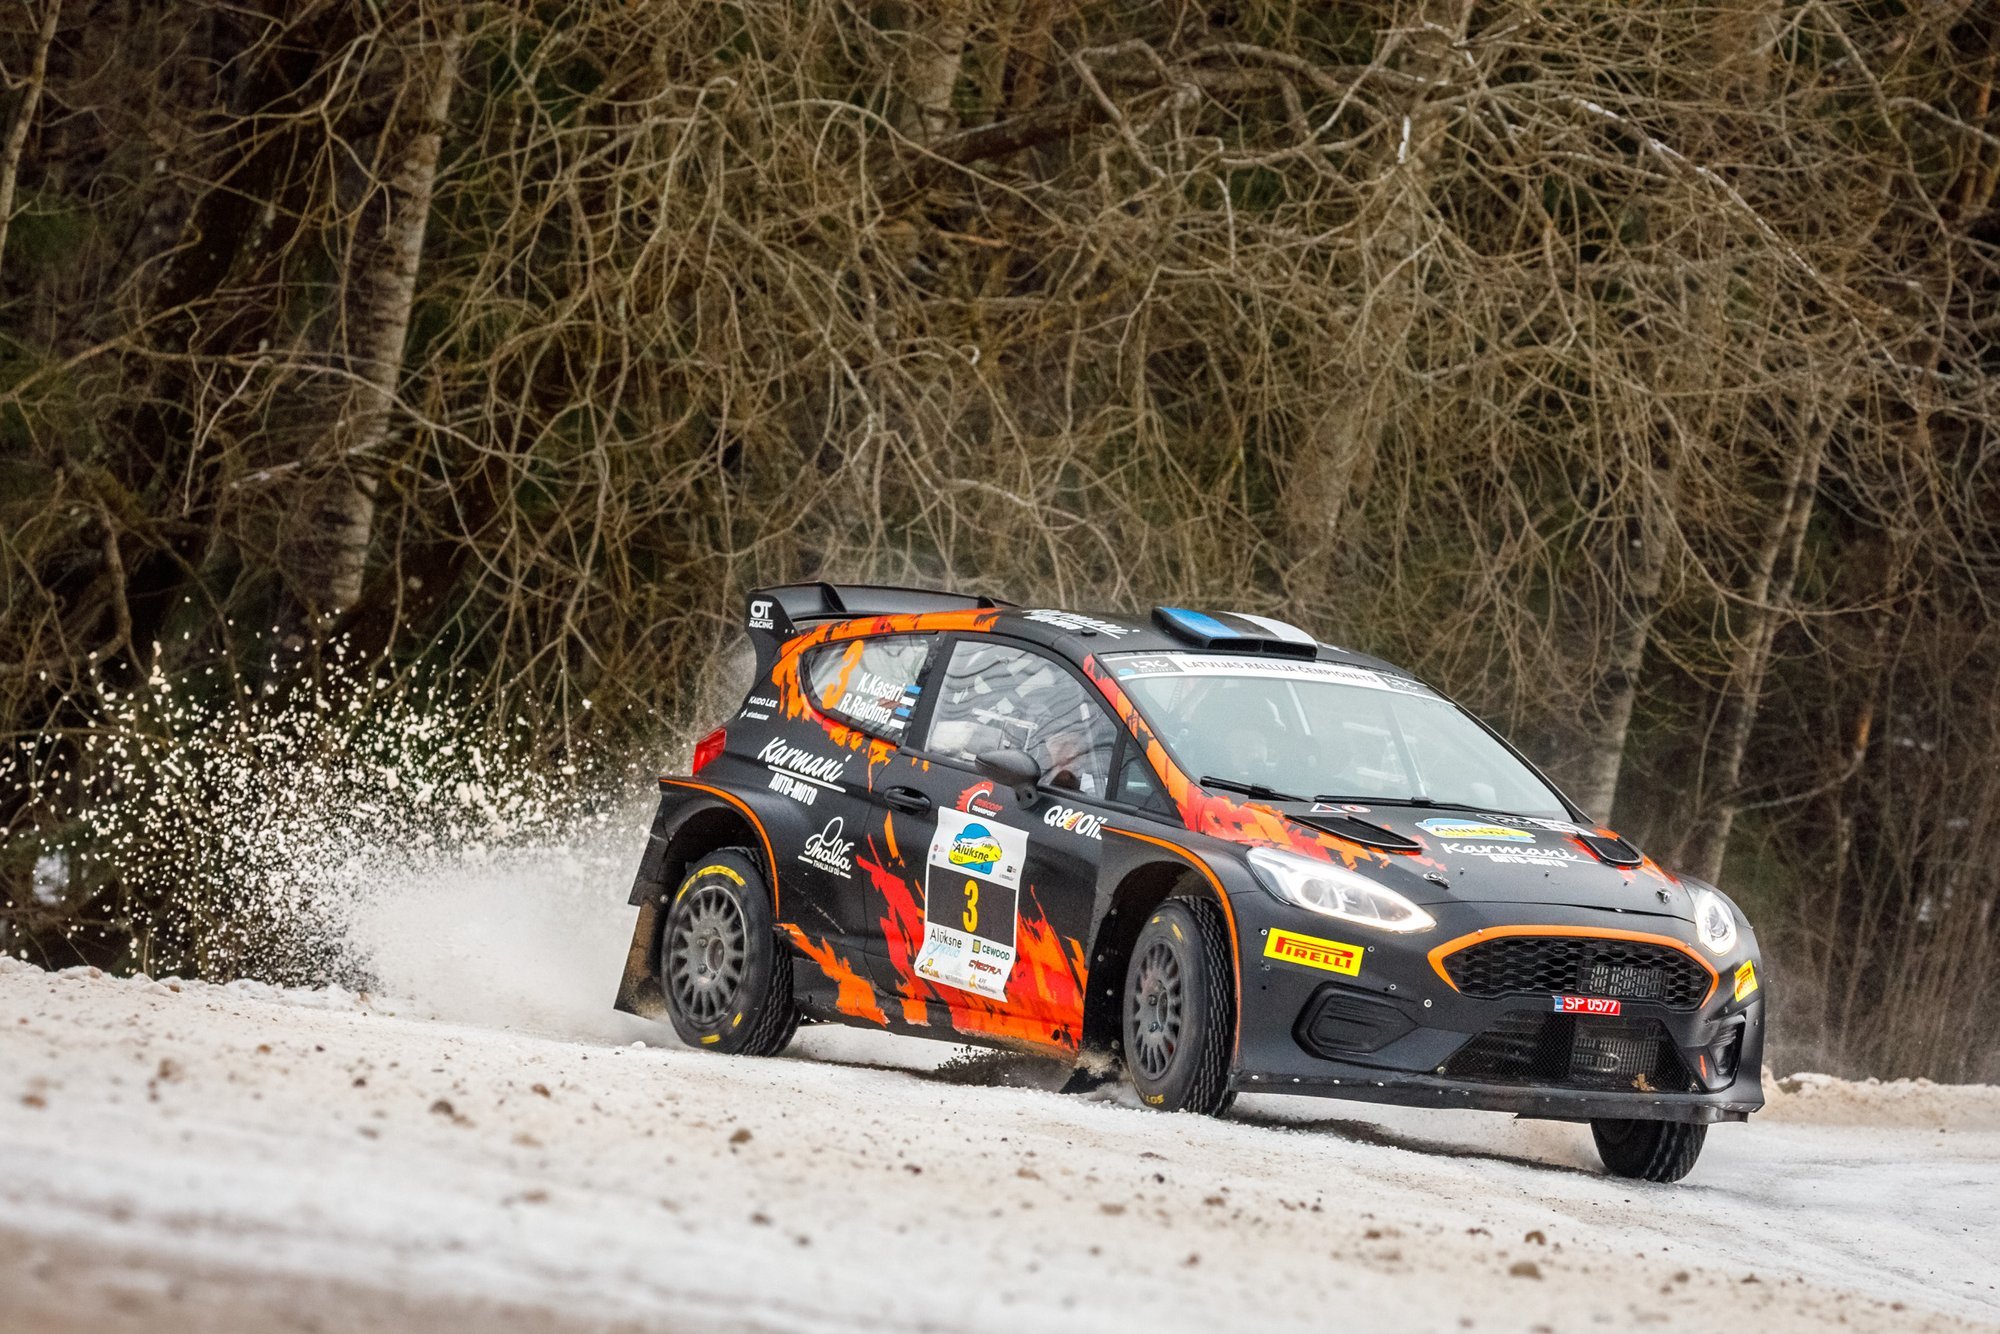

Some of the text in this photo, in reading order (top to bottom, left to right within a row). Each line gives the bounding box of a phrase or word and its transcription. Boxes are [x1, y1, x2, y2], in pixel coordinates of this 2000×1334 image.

[750, 600, 773, 619] OT
[749, 620, 774, 630] RACING
[822, 639, 865, 710] 3
[1183, 660, 1244, 670] LATVIJAS
[1245, 662, 1296, 672] RALLIJA
[856, 672, 906, 702] K.Kasari
[838, 692, 892, 725] R.Raidma
[757, 736, 852, 783] Karmani
[768, 772, 818, 806] AUTO-MOTO
[954, 843, 989, 862] Alūksne
[1440, 843, 1579, 861] Karmani
[962, 879, 979, 933] 3
[930, 928, 962, 949] Alūksne
[982, 944, 1010, 961] CEWOOD
[1274, 936, 1355, 969] PIRELLI
[1565, 997, 1617, 1013] SP 0577
